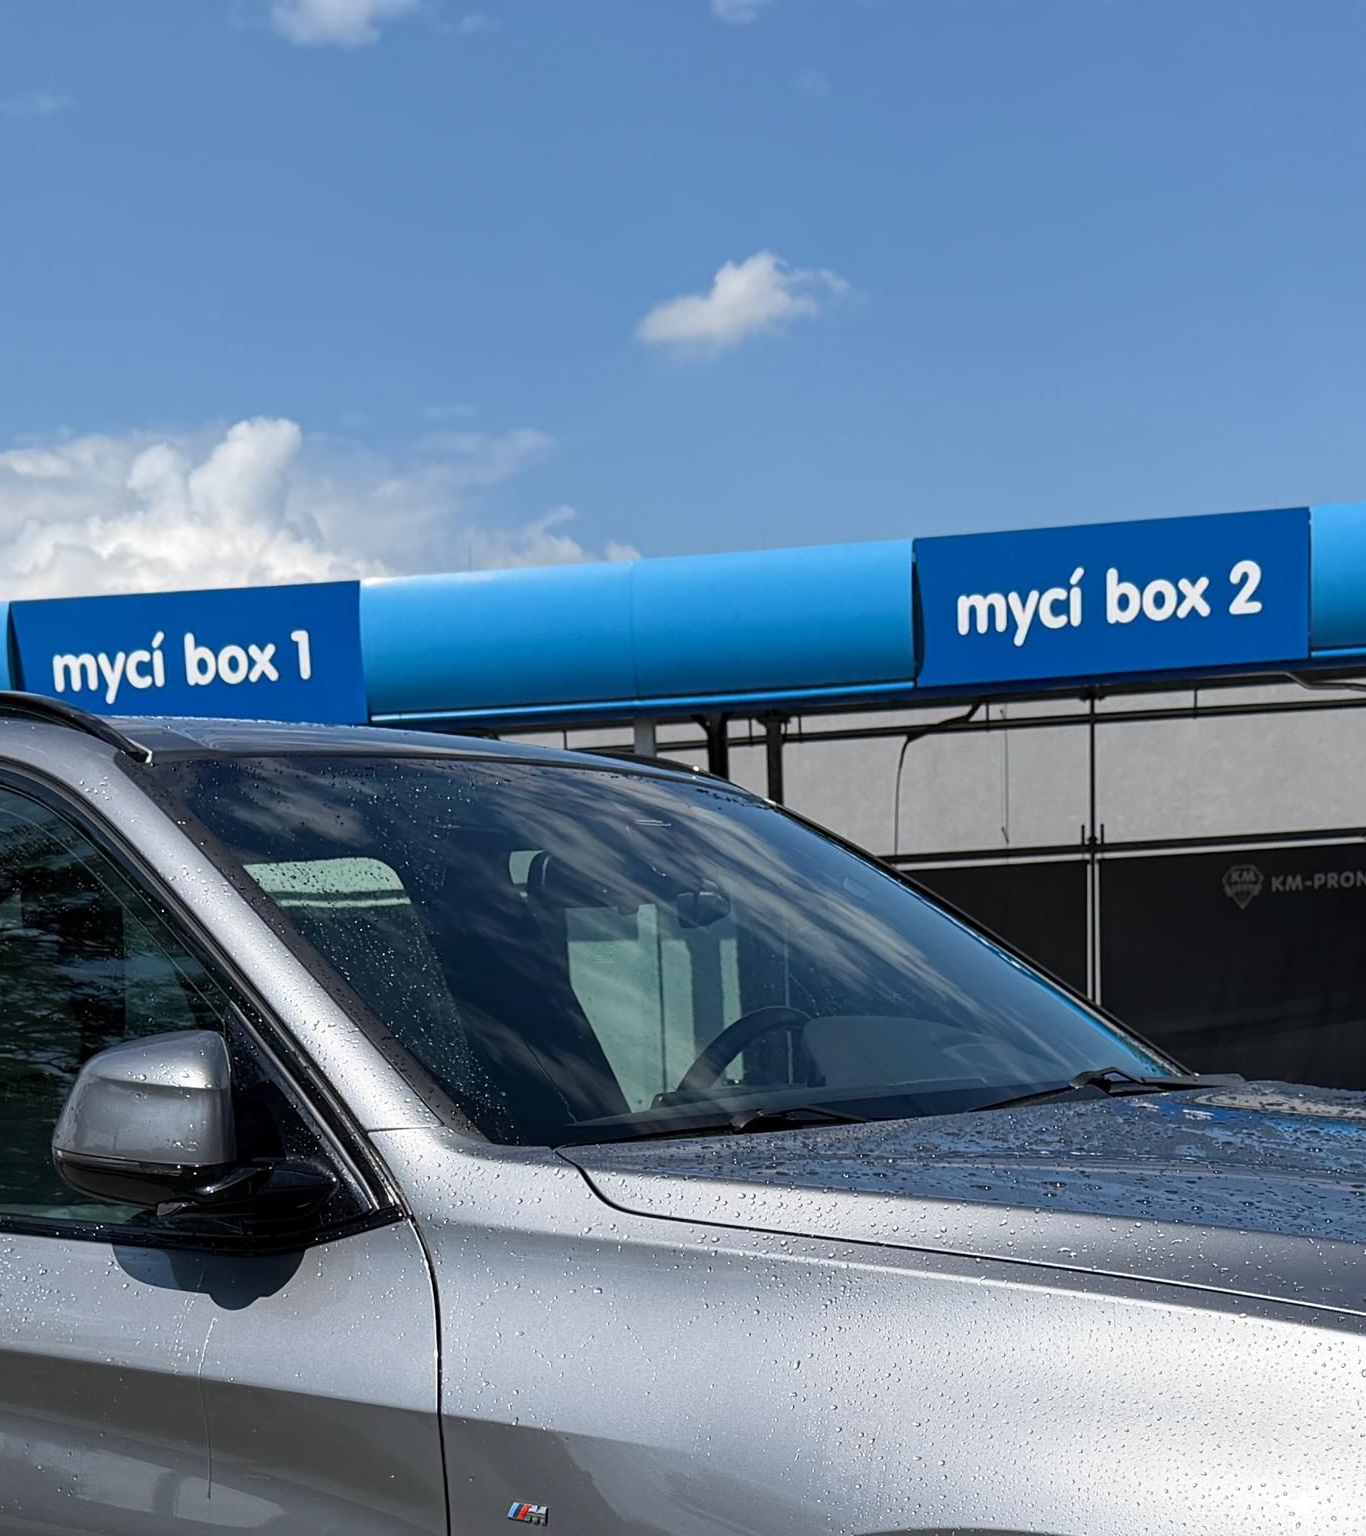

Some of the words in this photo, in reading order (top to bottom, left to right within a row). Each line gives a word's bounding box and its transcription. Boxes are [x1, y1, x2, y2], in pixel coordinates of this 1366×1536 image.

[957, 567, 1084, 647] mycí
[1106, 567, 1210, 624] box
[1229, 560, 1262, 615] 2
[52, 631, 165, 704] mycí
[184, 632, 279, 686] box
[291, 630, 311, 680] 1
[1230, 870, 1257, 883] KM
